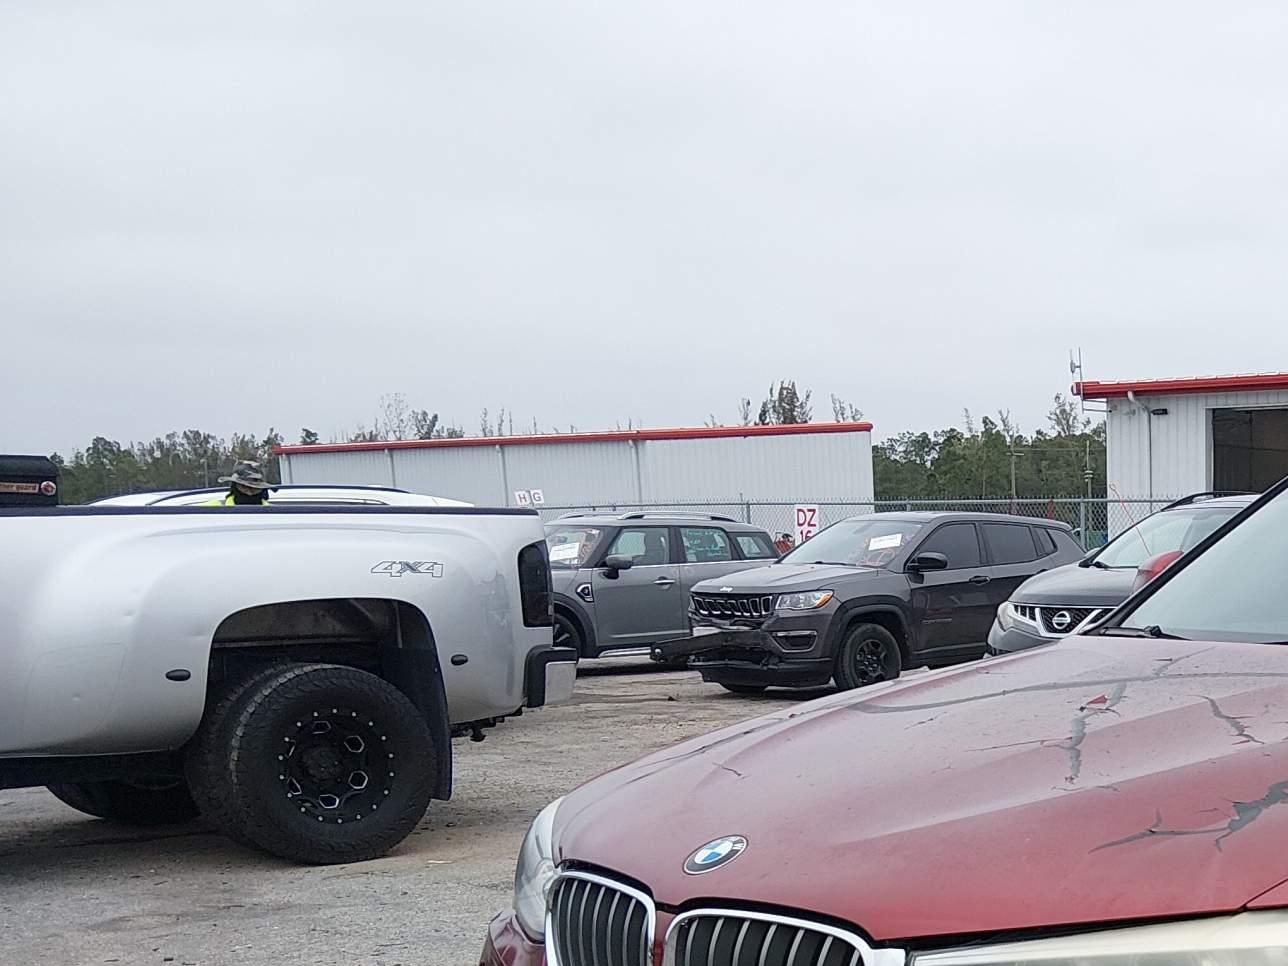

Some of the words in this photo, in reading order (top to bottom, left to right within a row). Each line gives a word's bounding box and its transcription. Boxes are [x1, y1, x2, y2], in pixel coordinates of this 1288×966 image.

[517, 493, 528, 503] H
[532, 491, 542, 502] G
[796, 508, 817, 528] DZ
